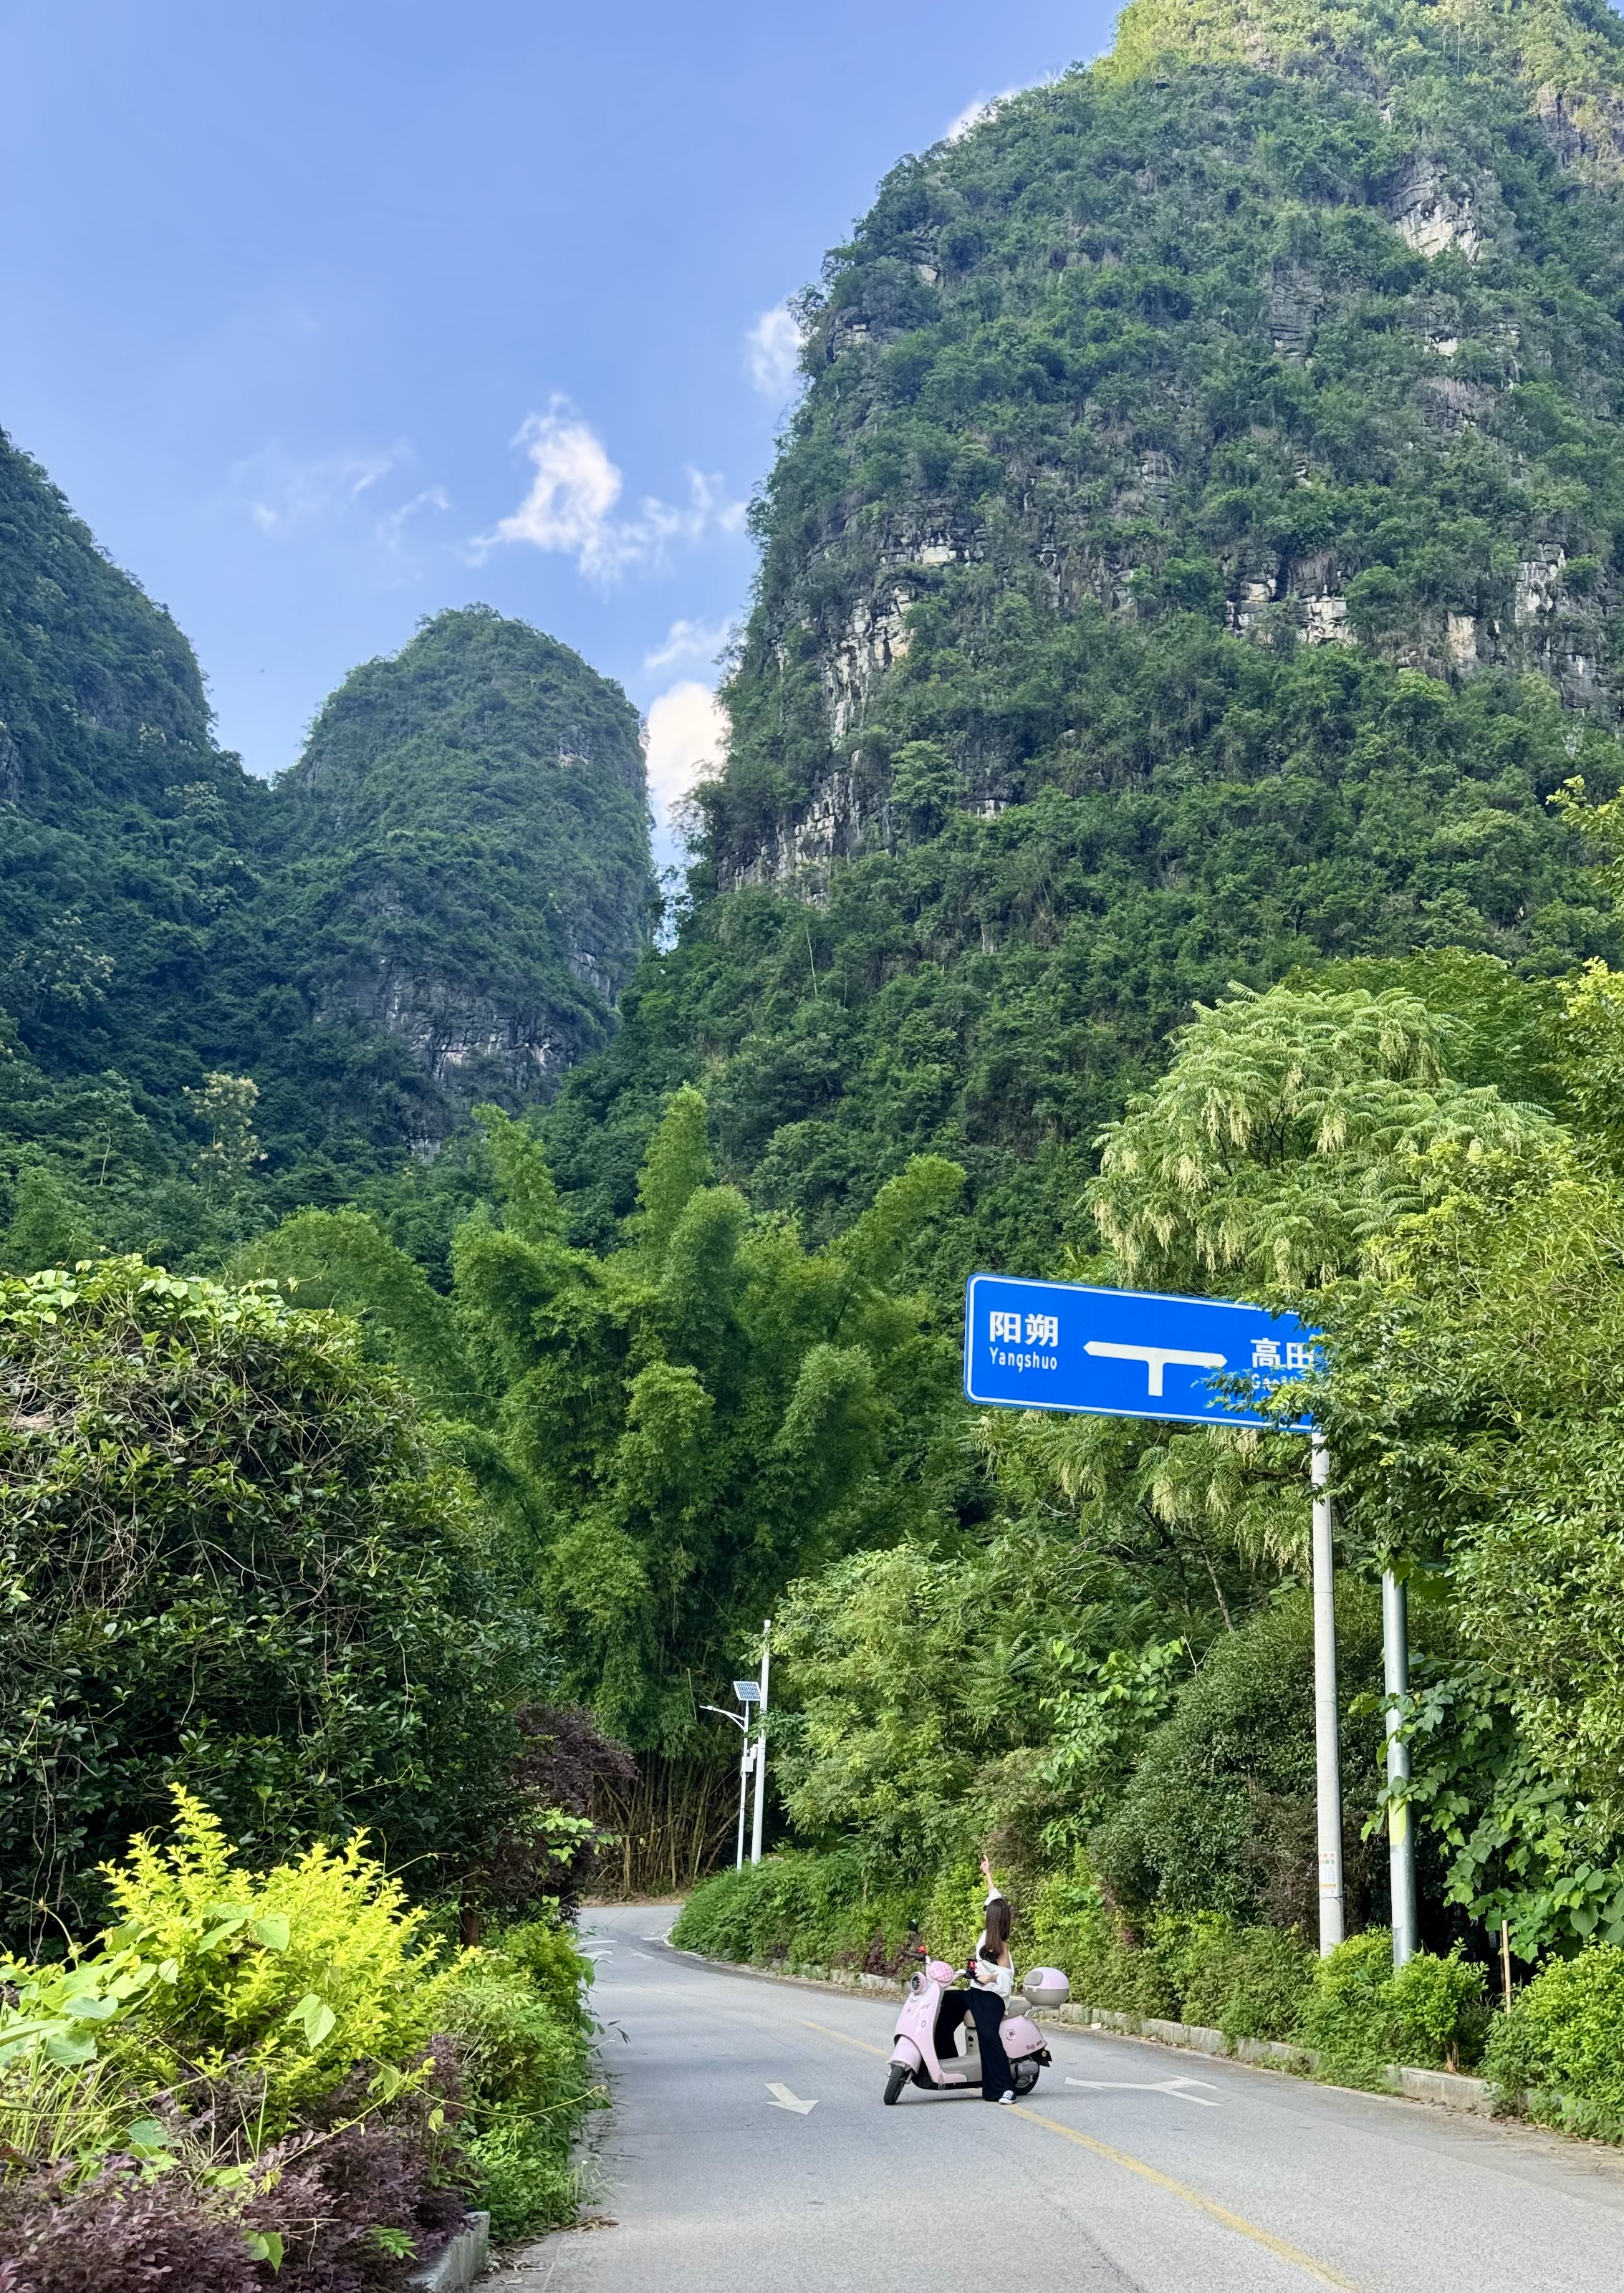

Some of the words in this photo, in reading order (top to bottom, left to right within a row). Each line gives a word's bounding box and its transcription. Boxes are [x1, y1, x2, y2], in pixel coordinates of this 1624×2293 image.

[989, 1311, 1059, 1347] 阳朔
[989, 1346, 1058, 1373] Yangshuo
[1250, 1337, 1315, 1370] 高田
